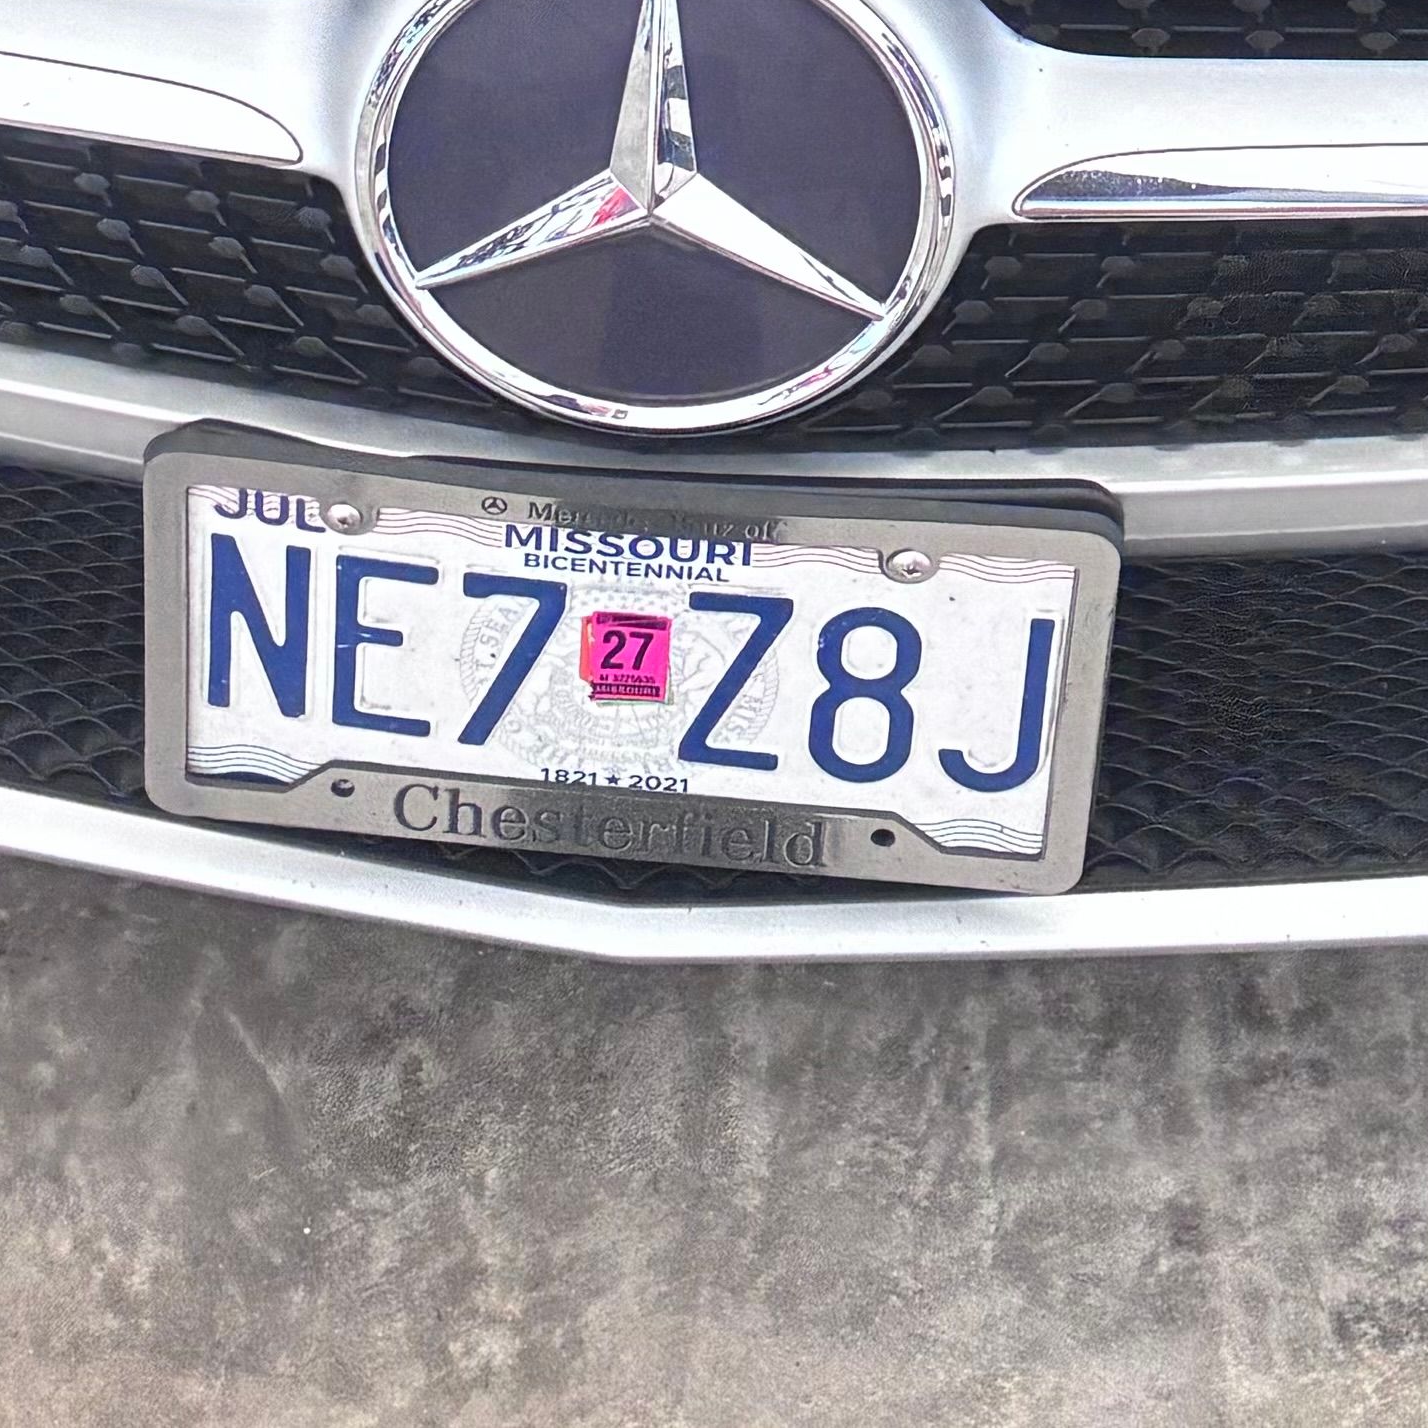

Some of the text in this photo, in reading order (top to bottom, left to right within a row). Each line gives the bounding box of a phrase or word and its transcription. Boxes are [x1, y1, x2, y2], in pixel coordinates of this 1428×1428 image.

[213, 488, 326, 533] JUL
[504, 523, 751, 566] MISSOURI
[523, 552, 730, 582] BICENTENNIAL
[207, 532, 1056, 793] NE7 Z8J
[600, 629, 654, 671] 27
[540, 767, 689, 793] 1821 2021
[393, 782, 827, 869] Chesterfield
